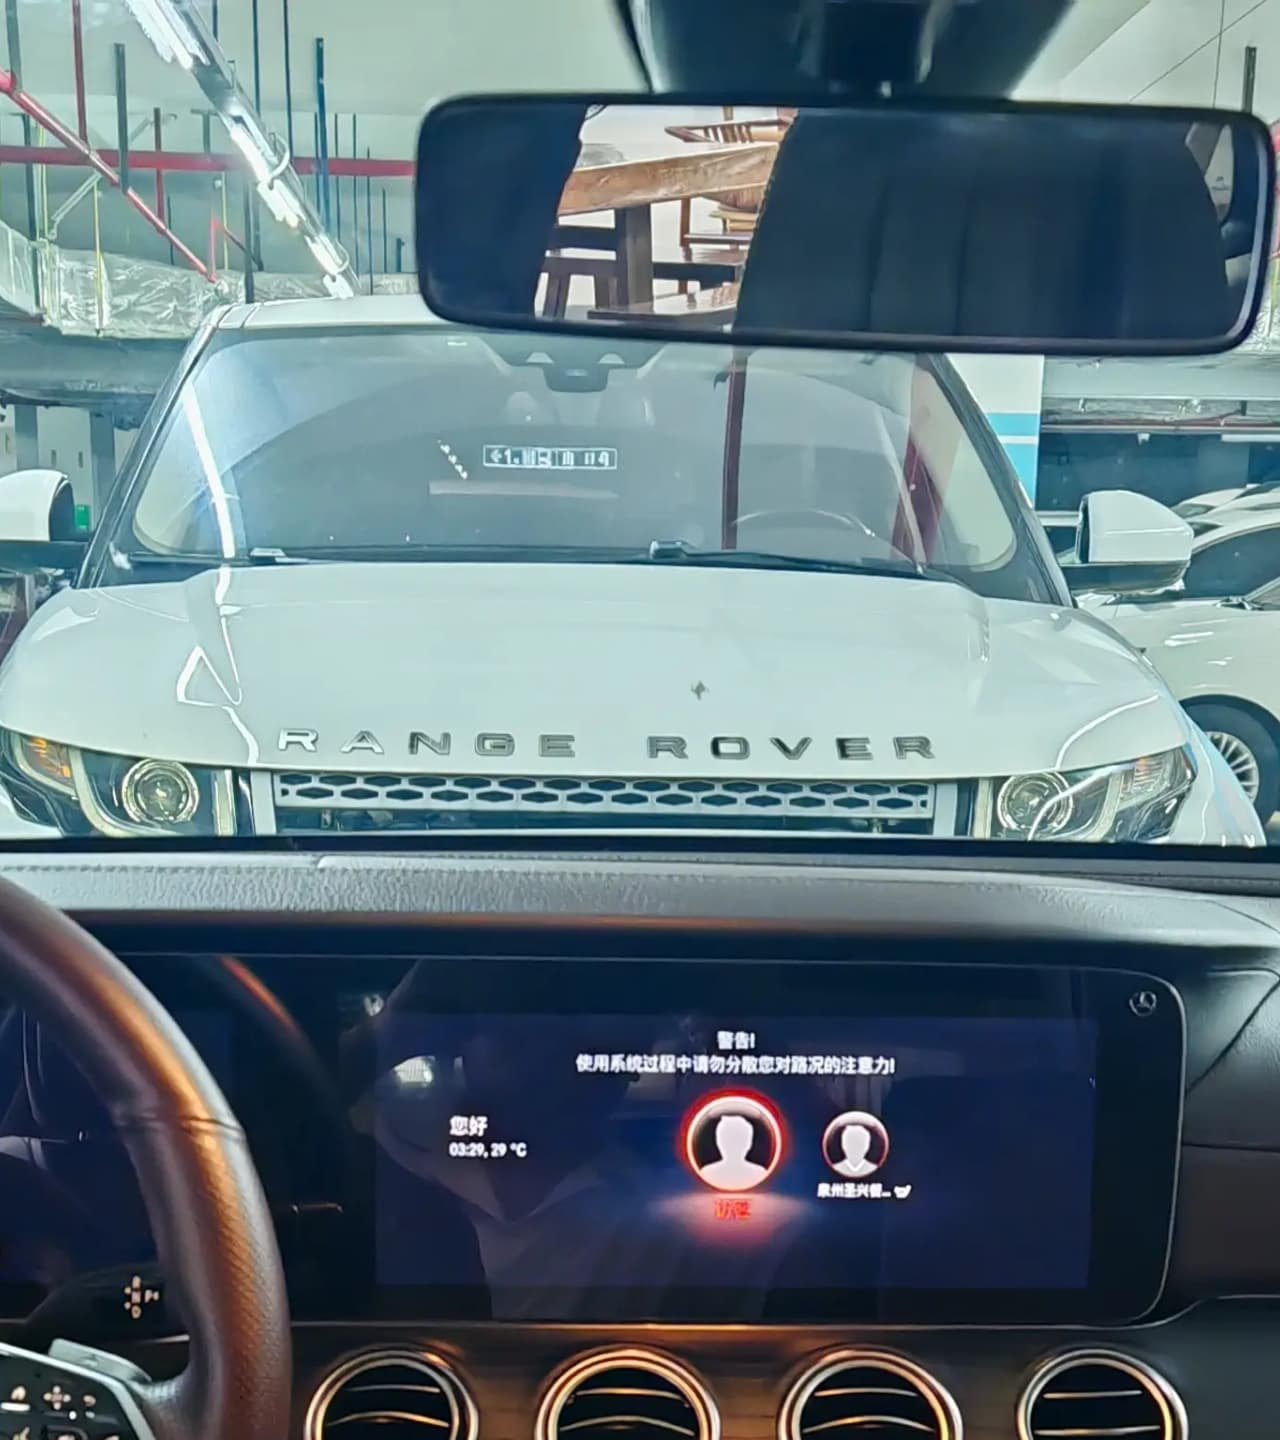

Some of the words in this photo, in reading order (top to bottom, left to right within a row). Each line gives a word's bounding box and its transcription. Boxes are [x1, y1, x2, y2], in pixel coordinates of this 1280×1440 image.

[277, 728, 576, 757] RANGE
[647, 735, 936, 760] ROVER
[449, 1115, 488, 1136] 您好
[490, 1142, 507, 1157] 29
